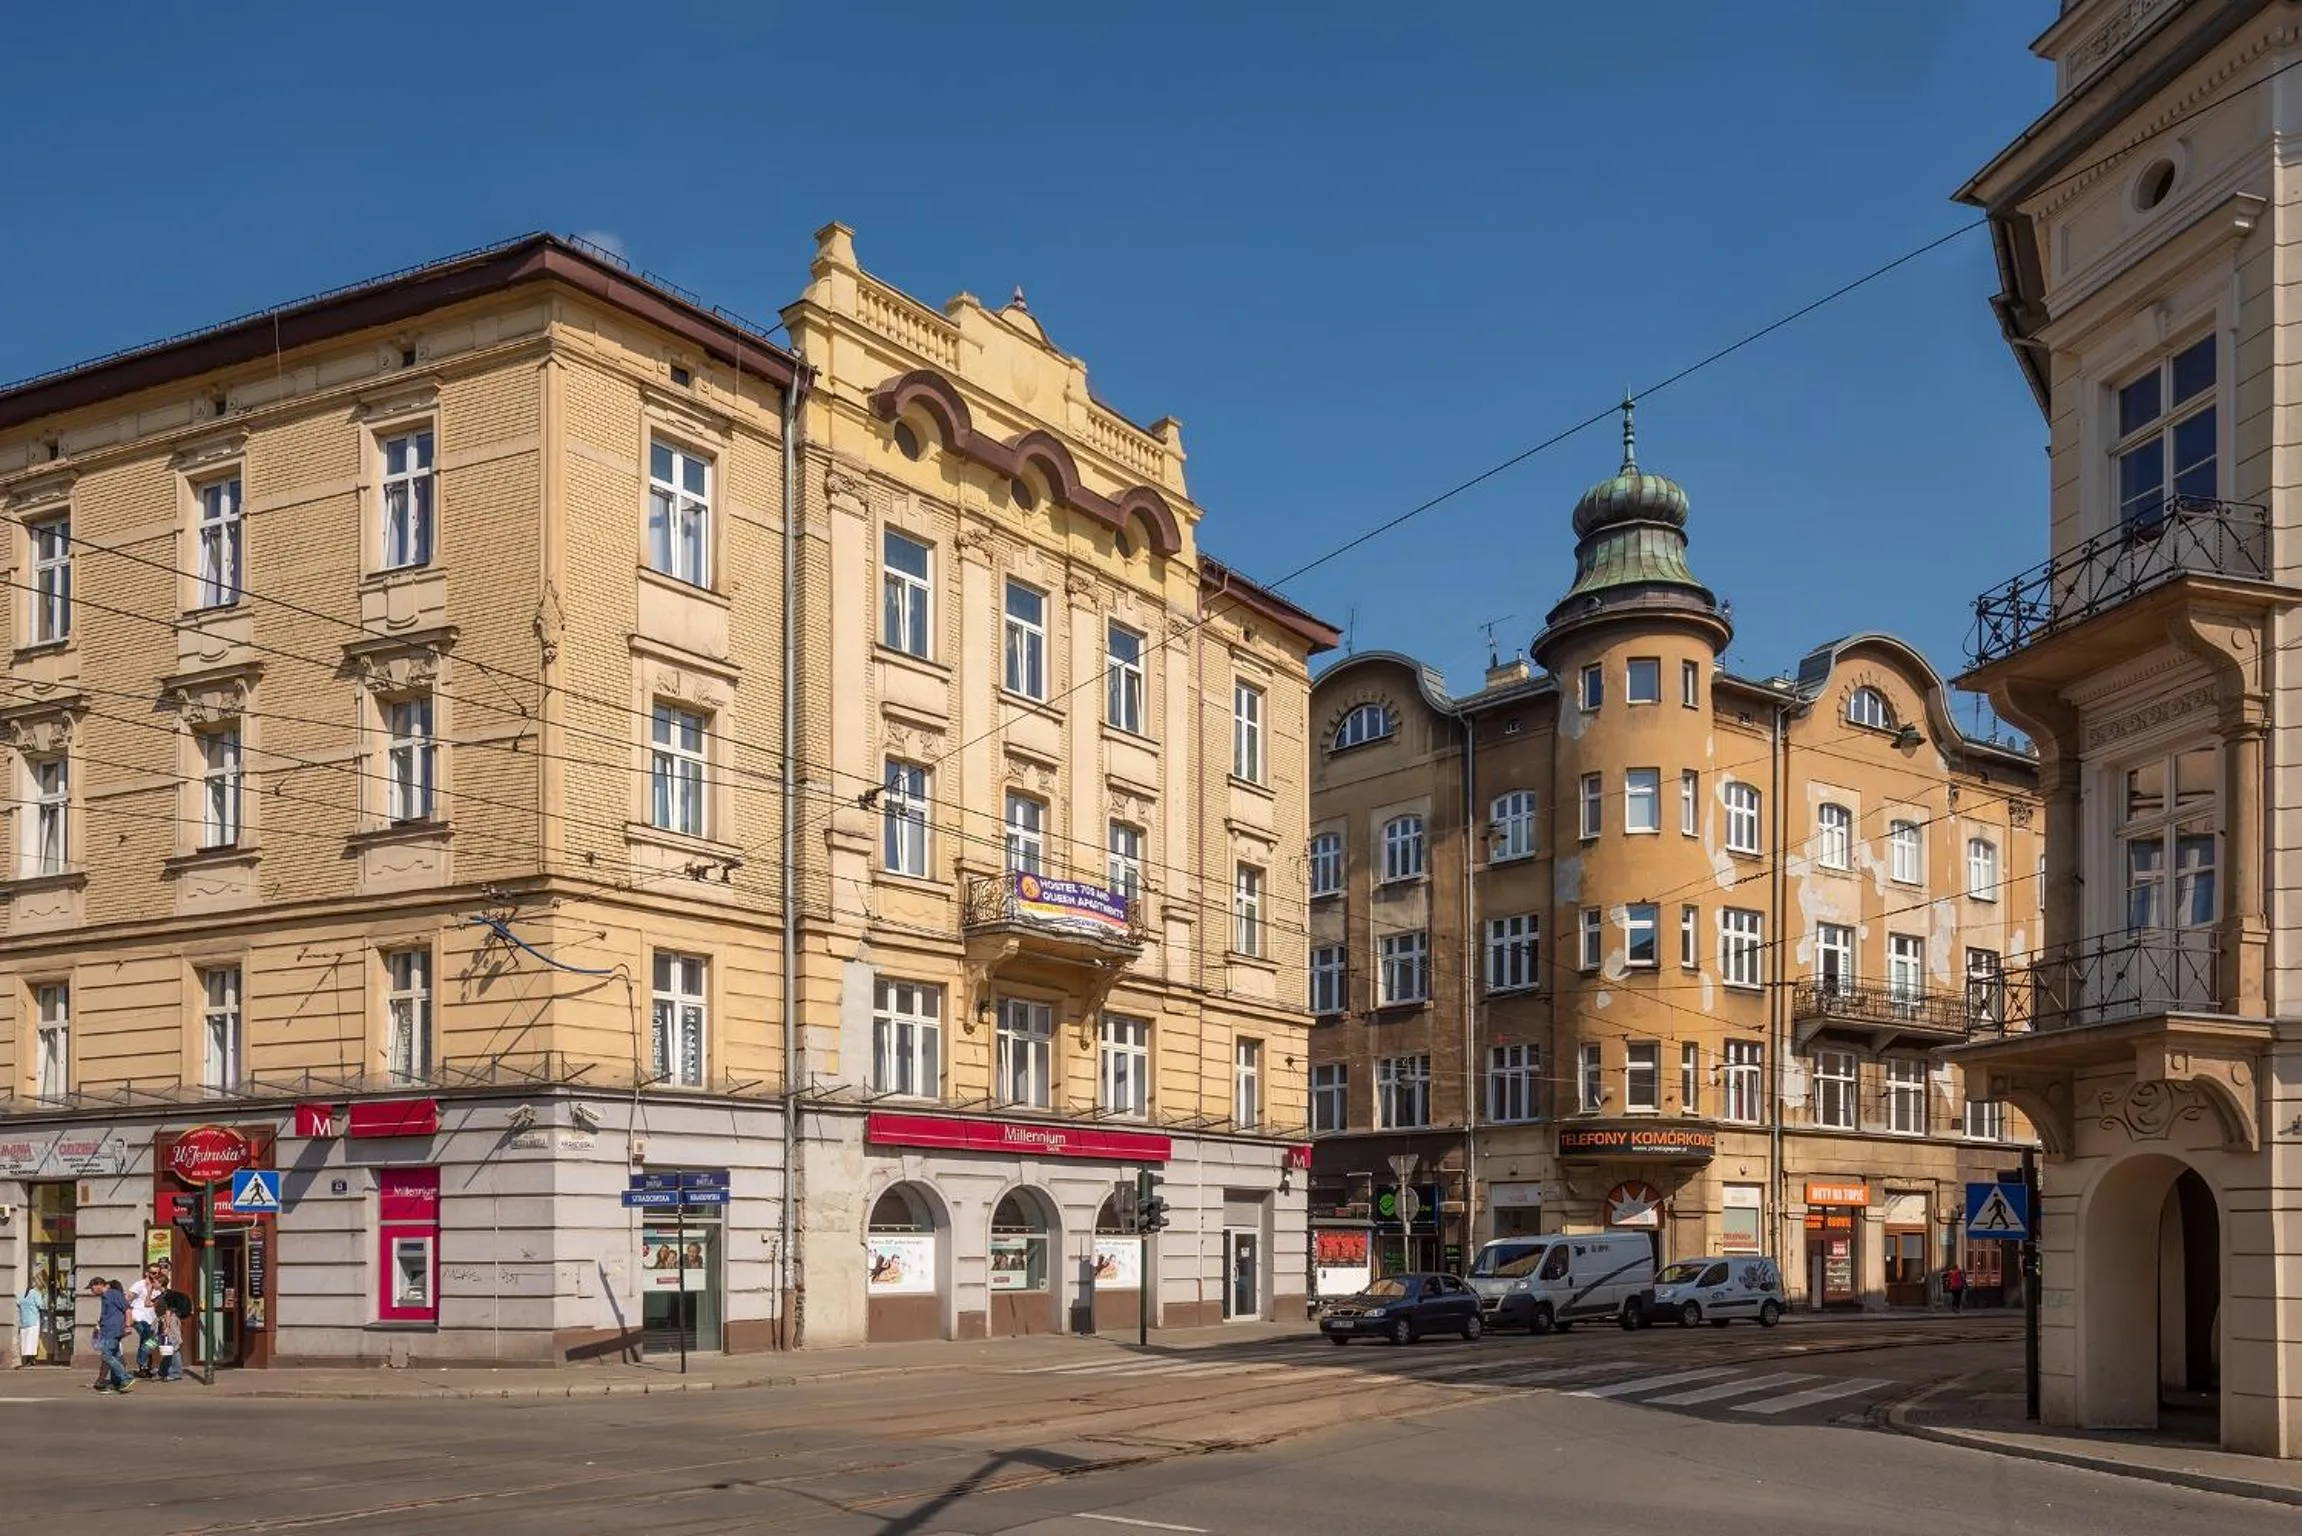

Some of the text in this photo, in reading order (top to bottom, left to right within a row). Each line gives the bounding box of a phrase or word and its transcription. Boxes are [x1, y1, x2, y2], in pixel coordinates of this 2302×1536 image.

[1040, 880, 1078, 894] HOSTEL
[1043, 891, 1077, 905] QUEEN
[311, 1112, 331, 1136] M
[1004, 1124, 1066, 1145] Millennium
[1560, 1129, 1715, 1147] TELEFONY KOMÓRKOWE
[1293, 1153, 1305, 1168] M
[394, 1185, 437, 1197] Millennium
